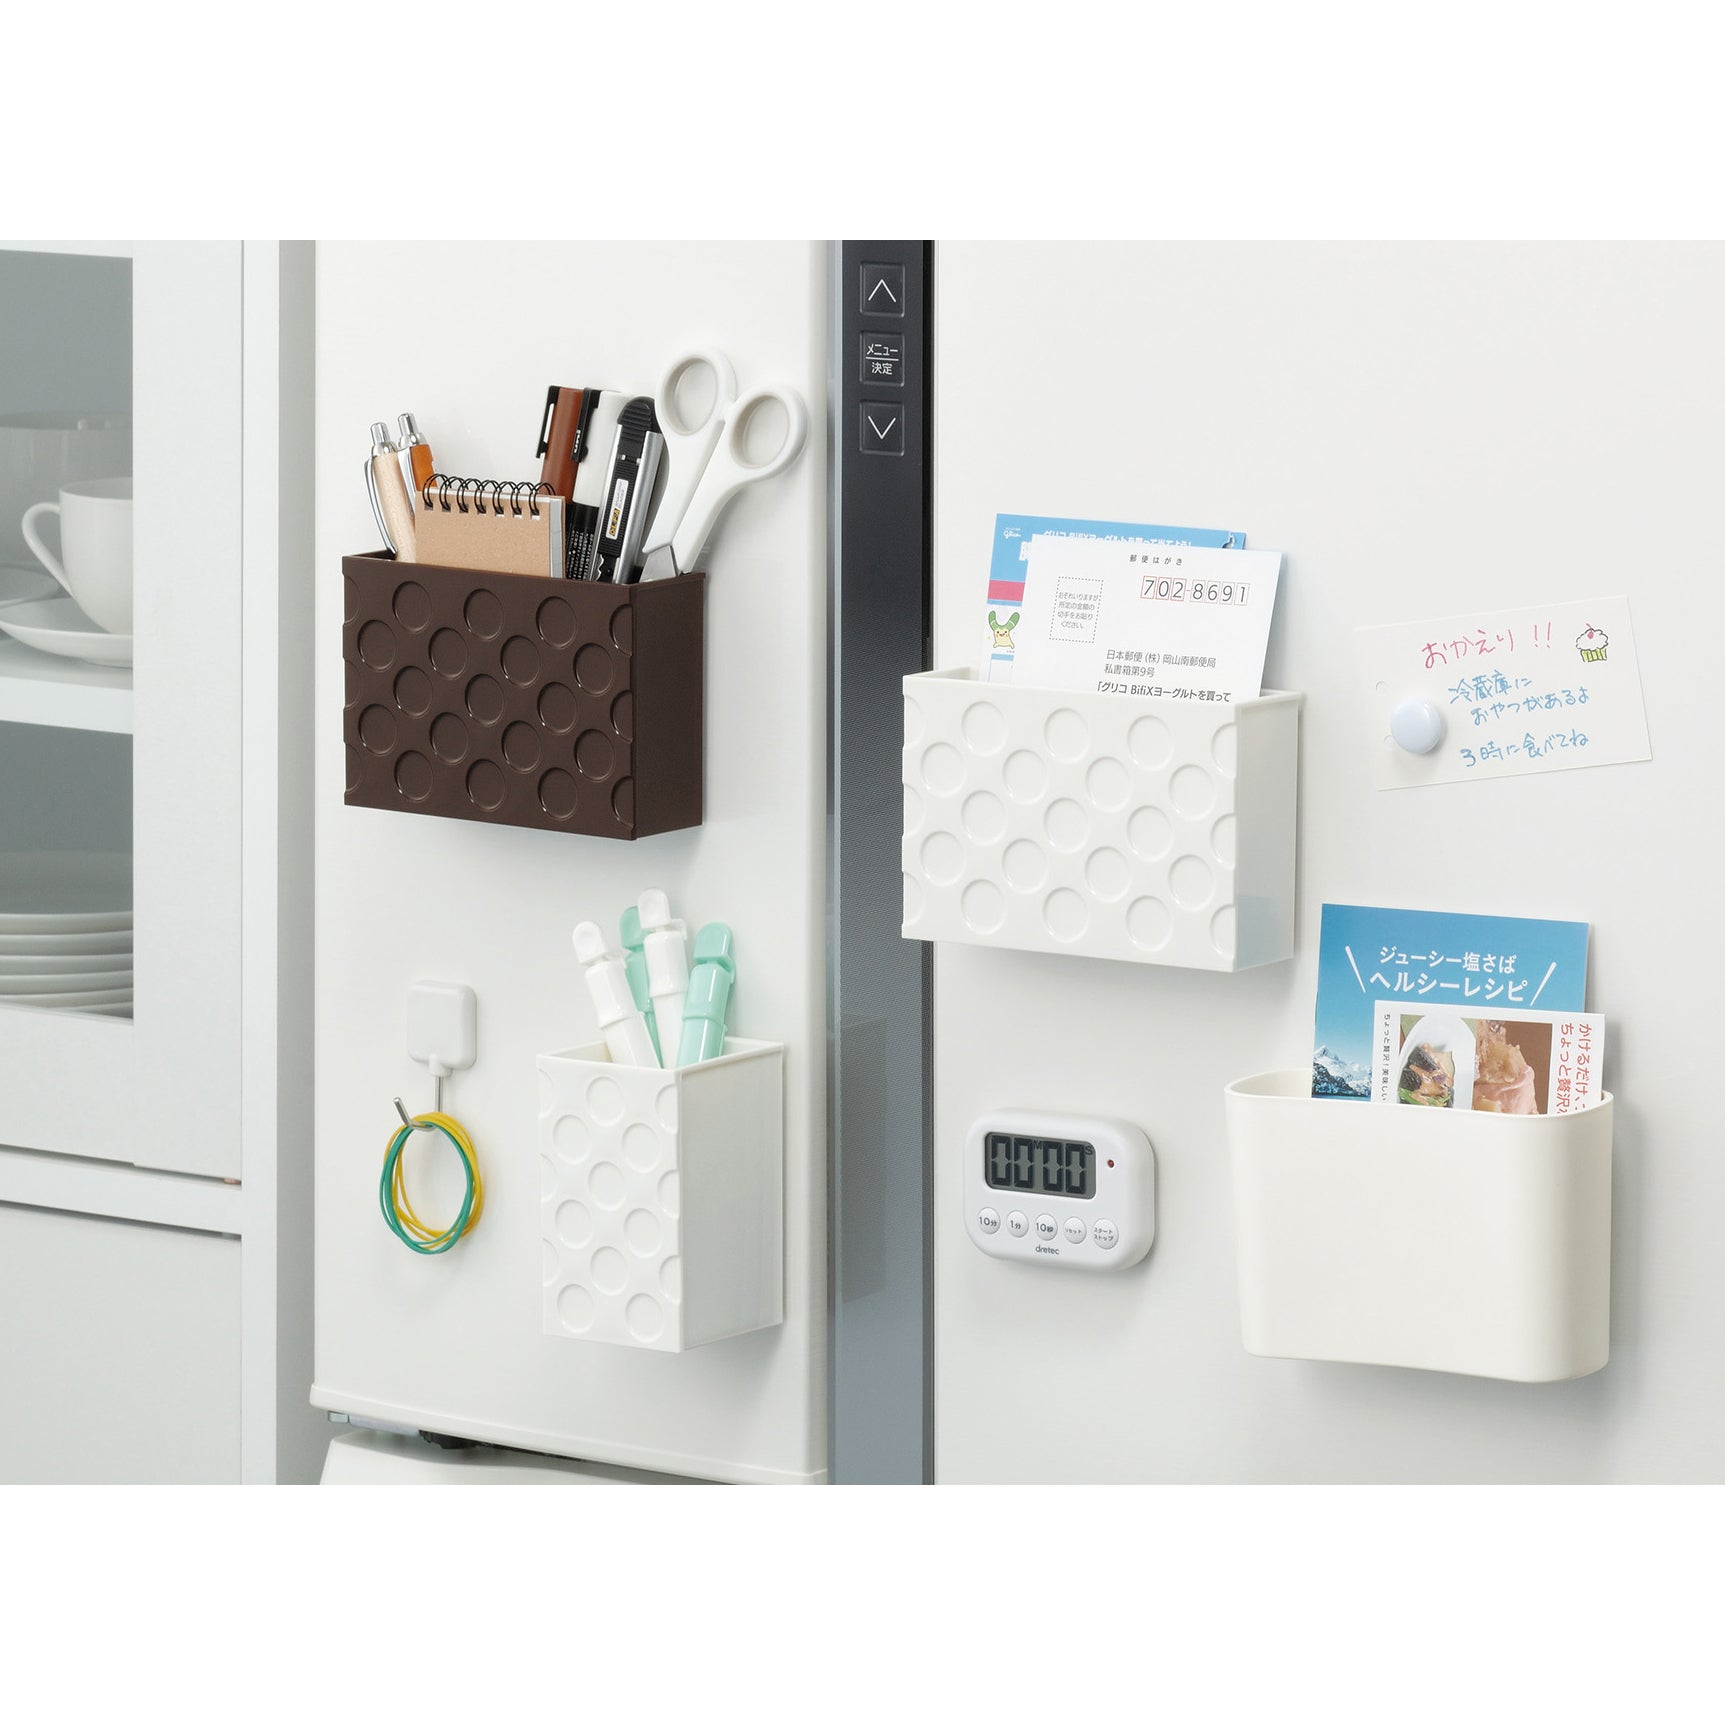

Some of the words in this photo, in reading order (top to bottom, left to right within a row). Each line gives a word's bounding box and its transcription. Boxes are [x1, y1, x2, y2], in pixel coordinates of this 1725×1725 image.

[866, 343, 899, 356] メニュー
[871, 362, 893, 375] 決定
[1129, 554, 1183, 566] 郵便はがき
[1104, 663, 1155, 677] 私書箱第9号
[1448, 669, 1533, 704] 冷蔵庫に
[1470, 686, 1591, 726] おやつがあるよ
[1459, 728, 1589, 768] 3時に食べてね
[1379, 945, 1517, 974] ジューシー塩さば
[1369, 972, 1528, 1002] ヘルシーレシピ
[979, 1216, 997, 1227] 10分
[1010, 1220, 1021, 1229] 1分
[1036, 1222, 1054, 1232] 10秒
[1035, 1244, 1060, 1255] dretec
